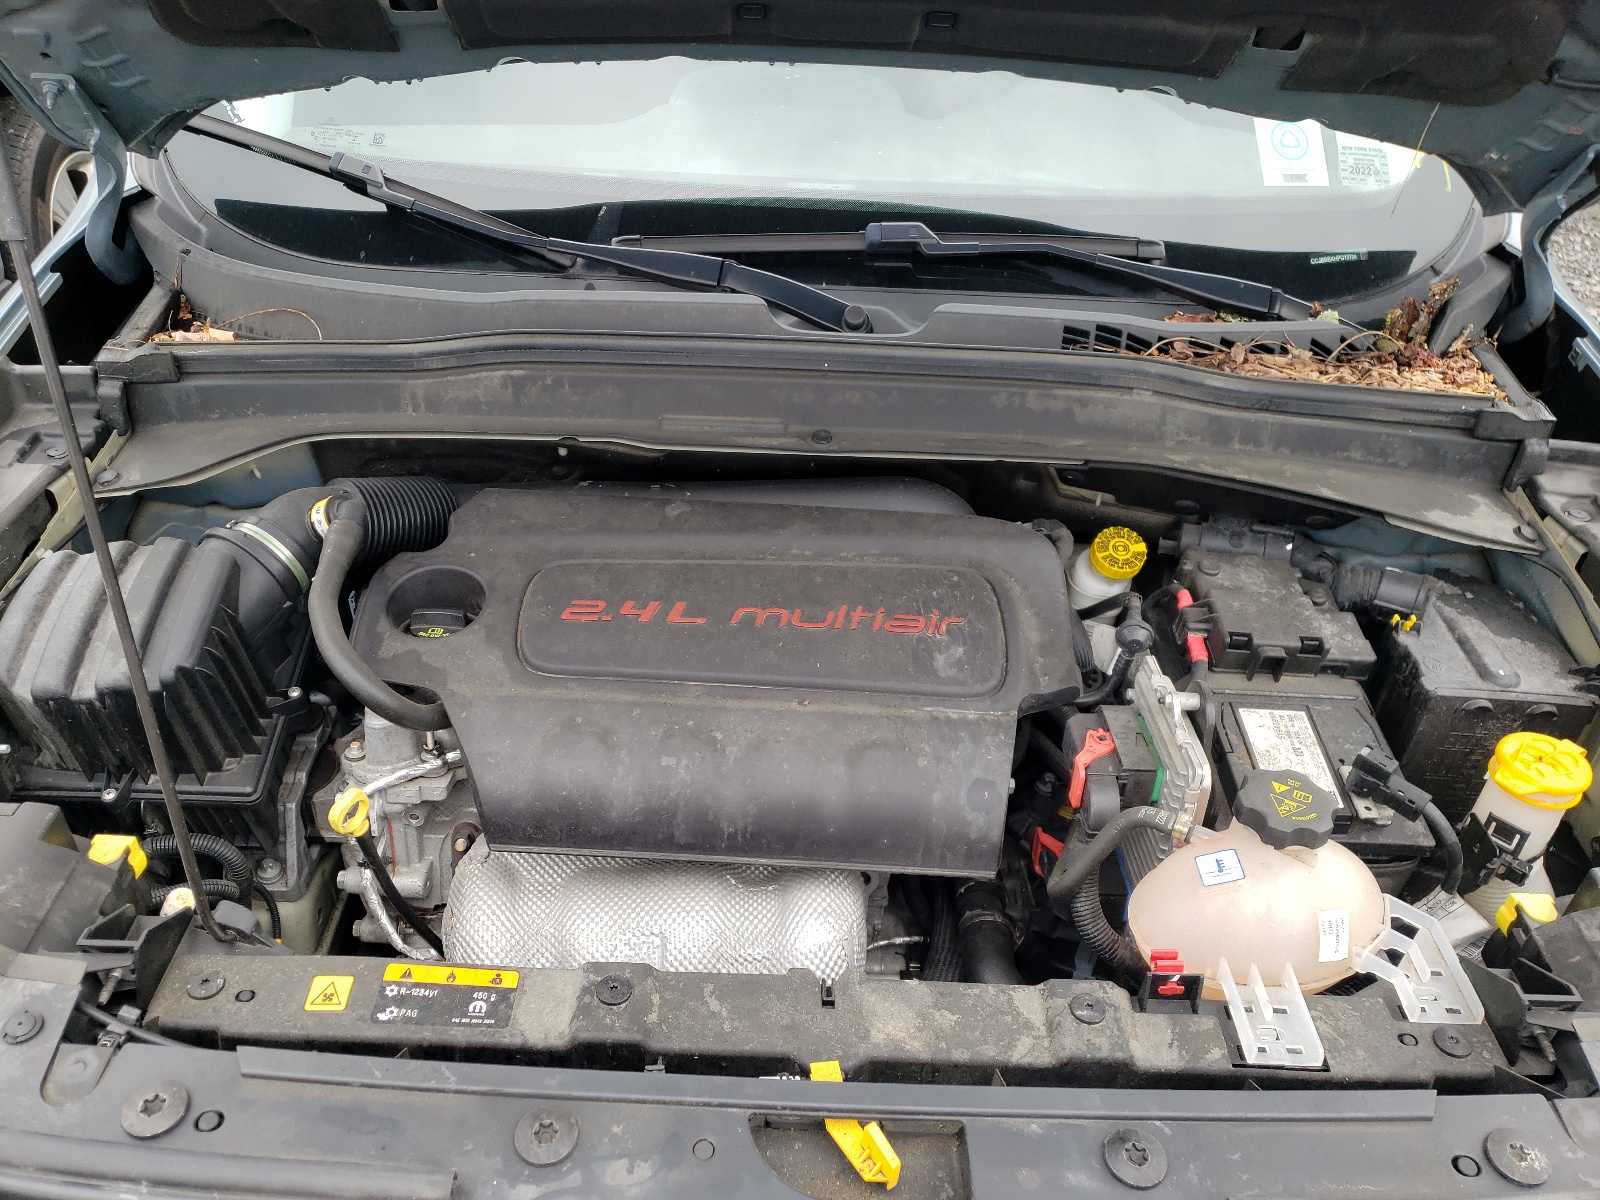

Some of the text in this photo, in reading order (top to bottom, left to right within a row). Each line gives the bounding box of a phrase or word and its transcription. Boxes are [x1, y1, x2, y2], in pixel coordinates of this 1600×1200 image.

[1350, 165, 1372, 176] 2022
[730, 603, 964, 637] multiair
[399, 986, 438, 998] R-1234yf
[399, 1008, 418, 1018] PAG
